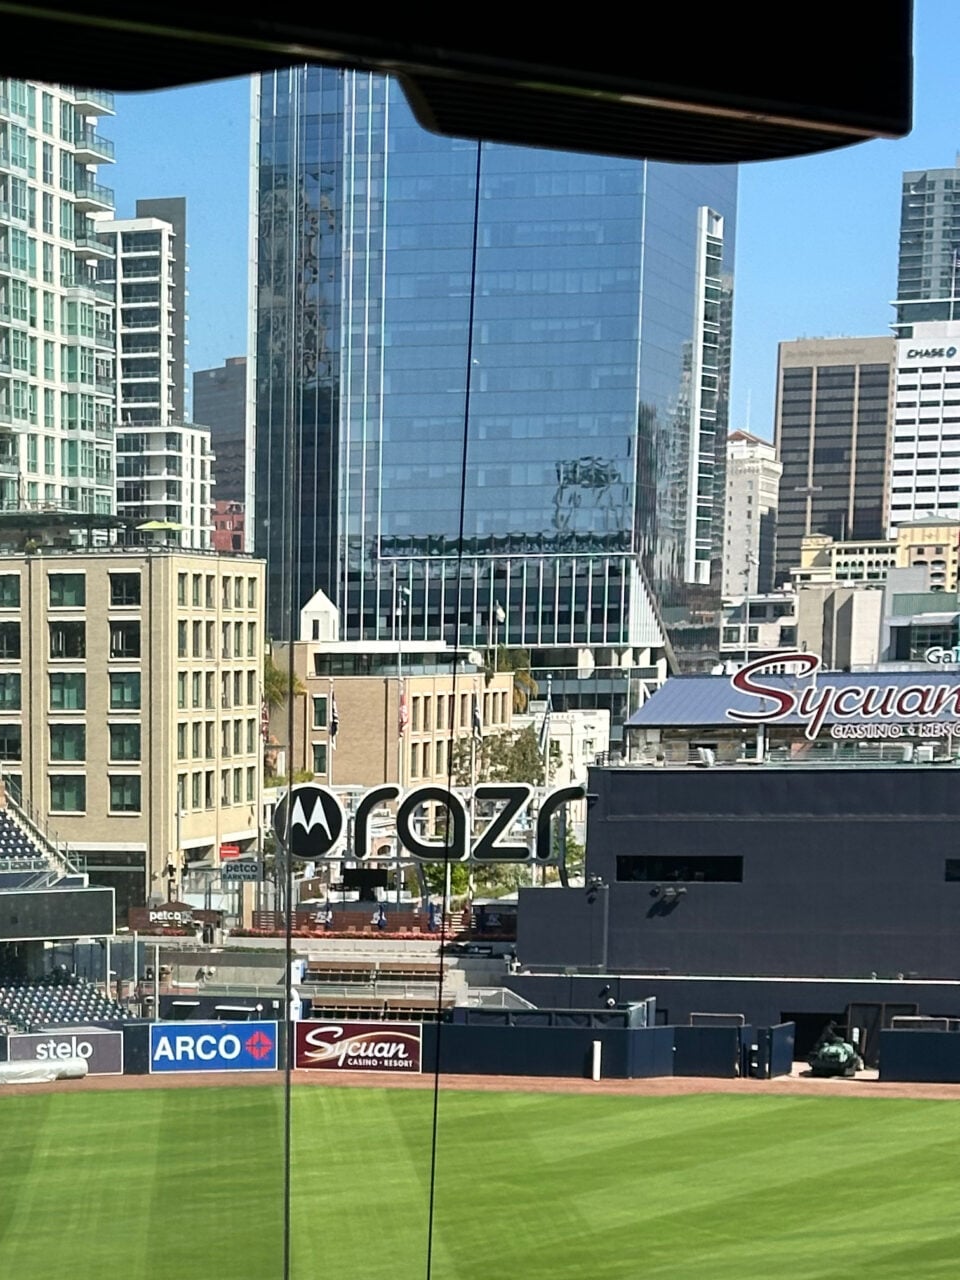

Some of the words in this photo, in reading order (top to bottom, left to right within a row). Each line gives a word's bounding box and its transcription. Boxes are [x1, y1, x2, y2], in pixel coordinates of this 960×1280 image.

[907, 348, 945, 358] CHASE
[726, 651, 960, 739] Sycuan
[831, 724, 901, 738] CASINO
[354, 783, 586, 861] razr
[226, 864, 258, 873] petco
[149, 911, 181, 921] petco
[36, 1036, 93, 1060] stelo
[153, 1034, 241, 1061] ARCO
[304, 1026, 408, 1067] Sycuan
[347, 1058, 378, 1066] CASINO
